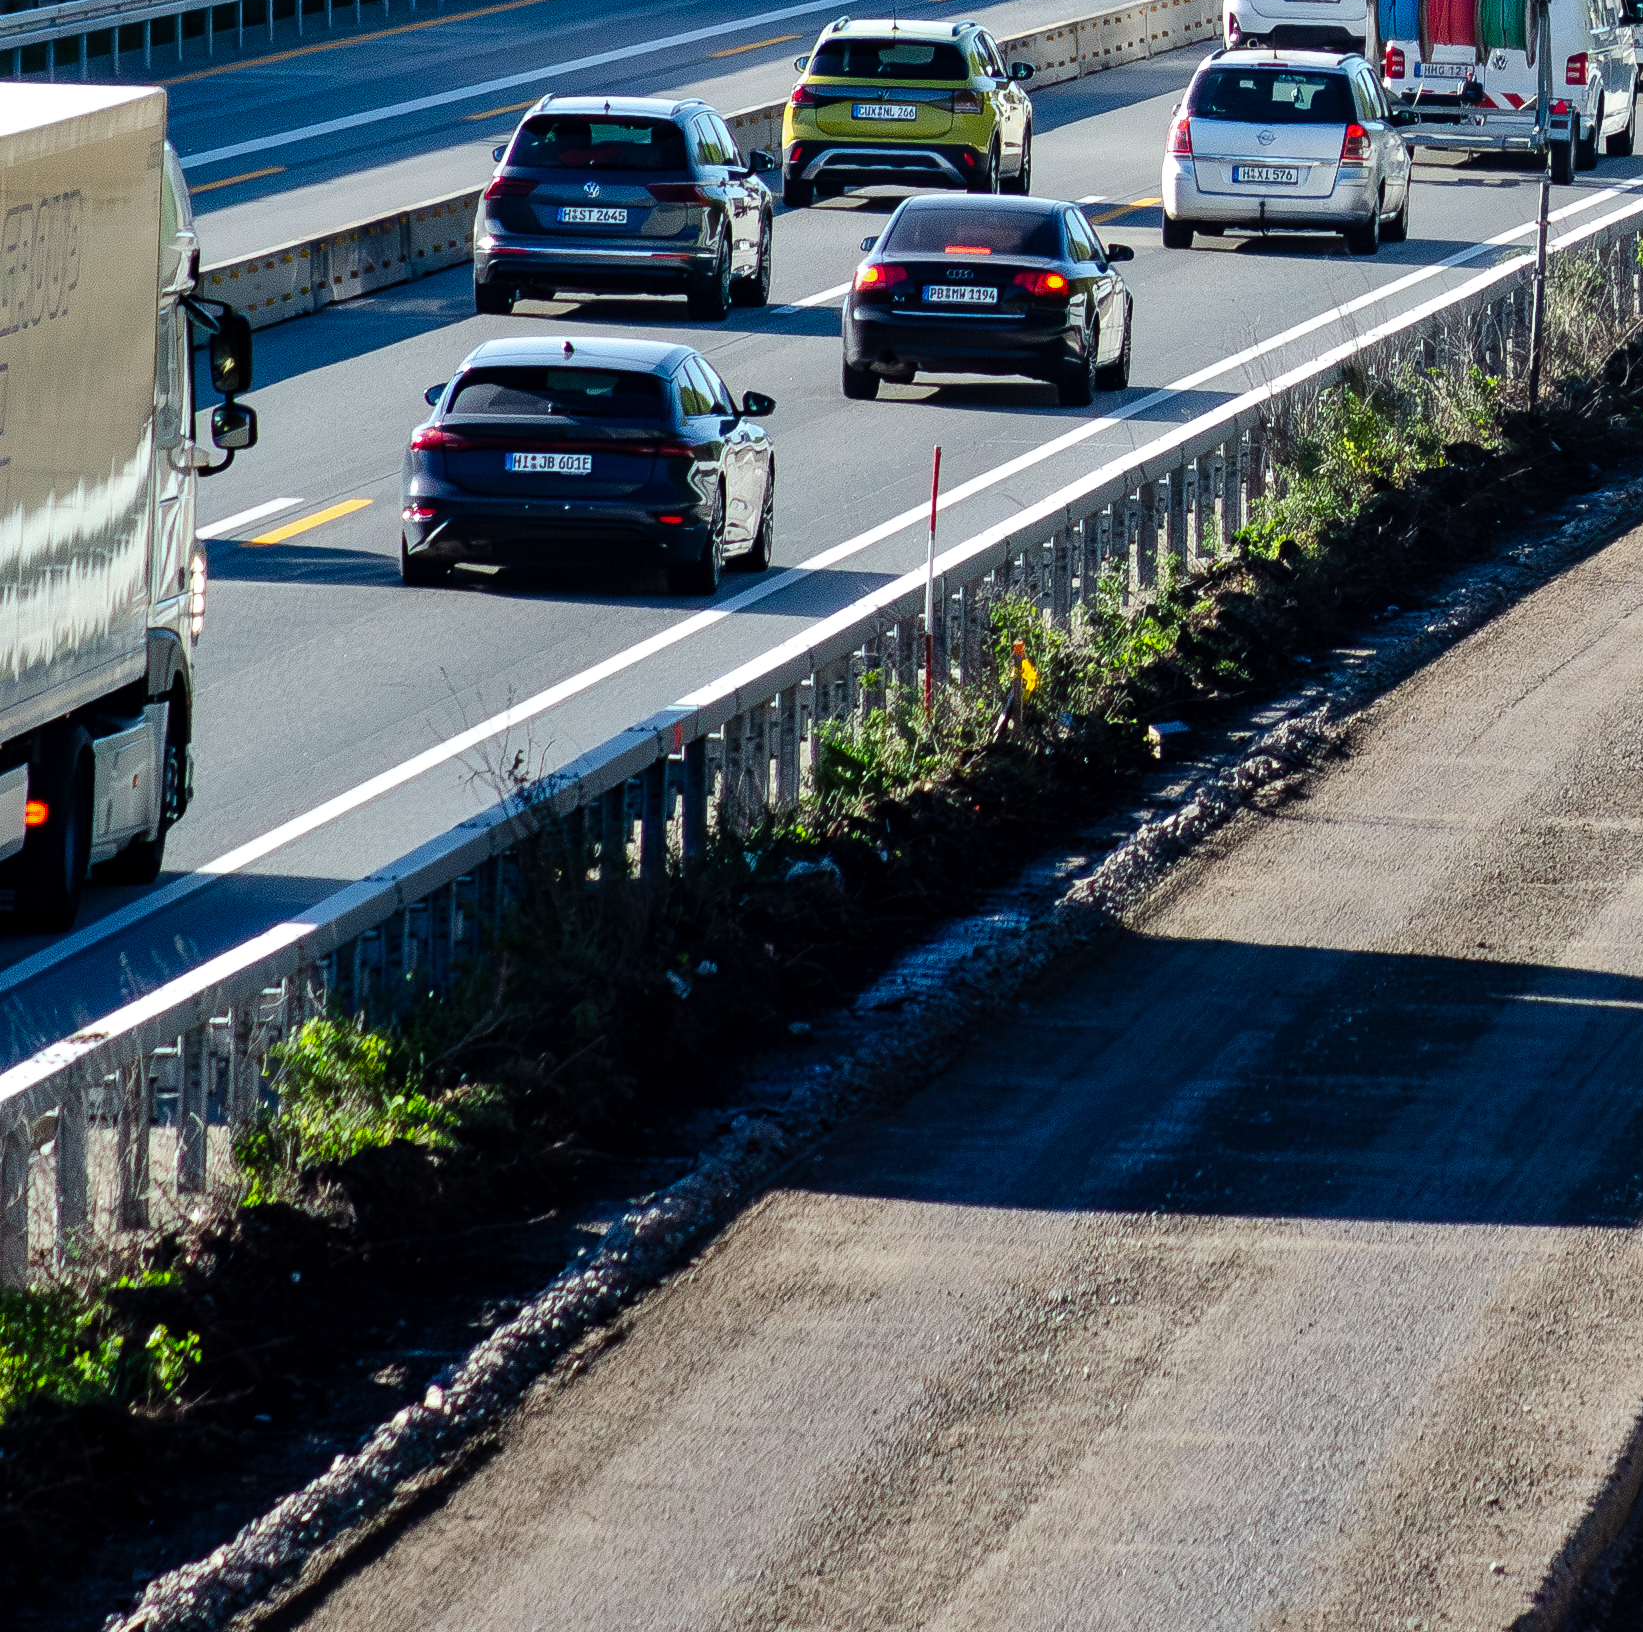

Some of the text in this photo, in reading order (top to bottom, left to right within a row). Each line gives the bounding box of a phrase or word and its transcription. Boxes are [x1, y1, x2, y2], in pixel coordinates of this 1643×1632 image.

[1273, 169, 1293, 180] 576
[579, 209, 594, 220] ST
[596, 210, 626, 222] 2645
[513, 455, 529, 469] HI
[539, 456, 555, 469] JB
